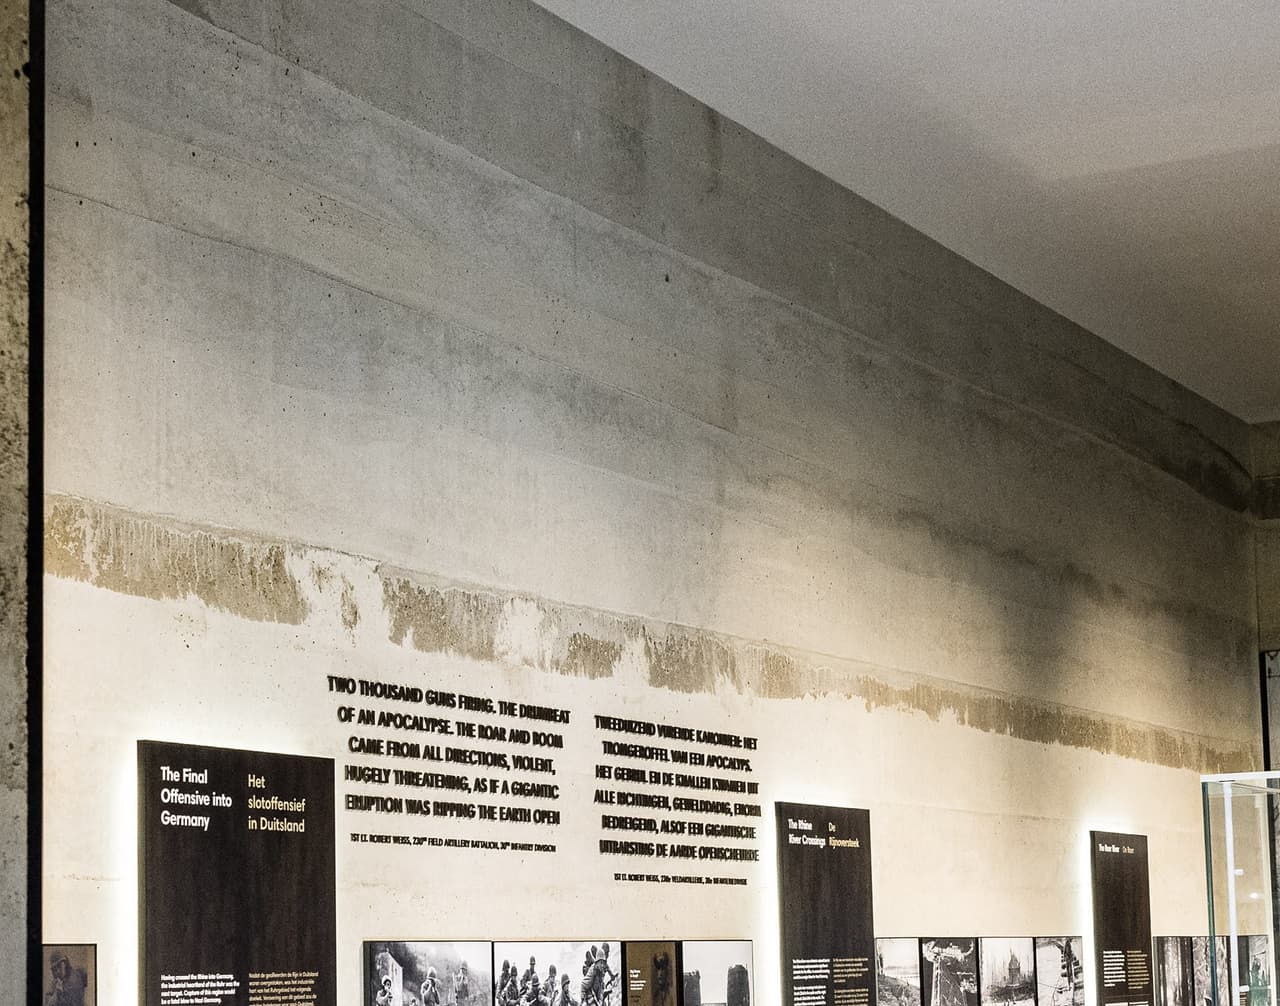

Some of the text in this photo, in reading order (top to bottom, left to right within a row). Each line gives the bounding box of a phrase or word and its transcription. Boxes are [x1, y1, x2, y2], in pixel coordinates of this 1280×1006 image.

[328, 676, 571, 723] TWO THOUSAND GUNS FIRING. THE DRUMBEAT
[337, 706, 563, 748] OF AN APOCALYPSE. THE ROAR AND BOOM
[348, 736, 555, 775] CAME FROM ALL DIRECTIONS, VIOLENT,
[161, 766, 208, 784] The Final
[248, 774, 266, 788] Het
[345, 765, 559, 799] HUGELY THREATENING, AS IF A GIGANTIC
[161, 788, 232, 807] Offensive into
[248, 796, 306, 812] slotoffensief
[345, 794, 560, 824] ERUPTION WAS RIPPING THE EARTH OPEN
[161, 810, 210, 831] Germany
[248, 816, 305, 832] in Duitsland
